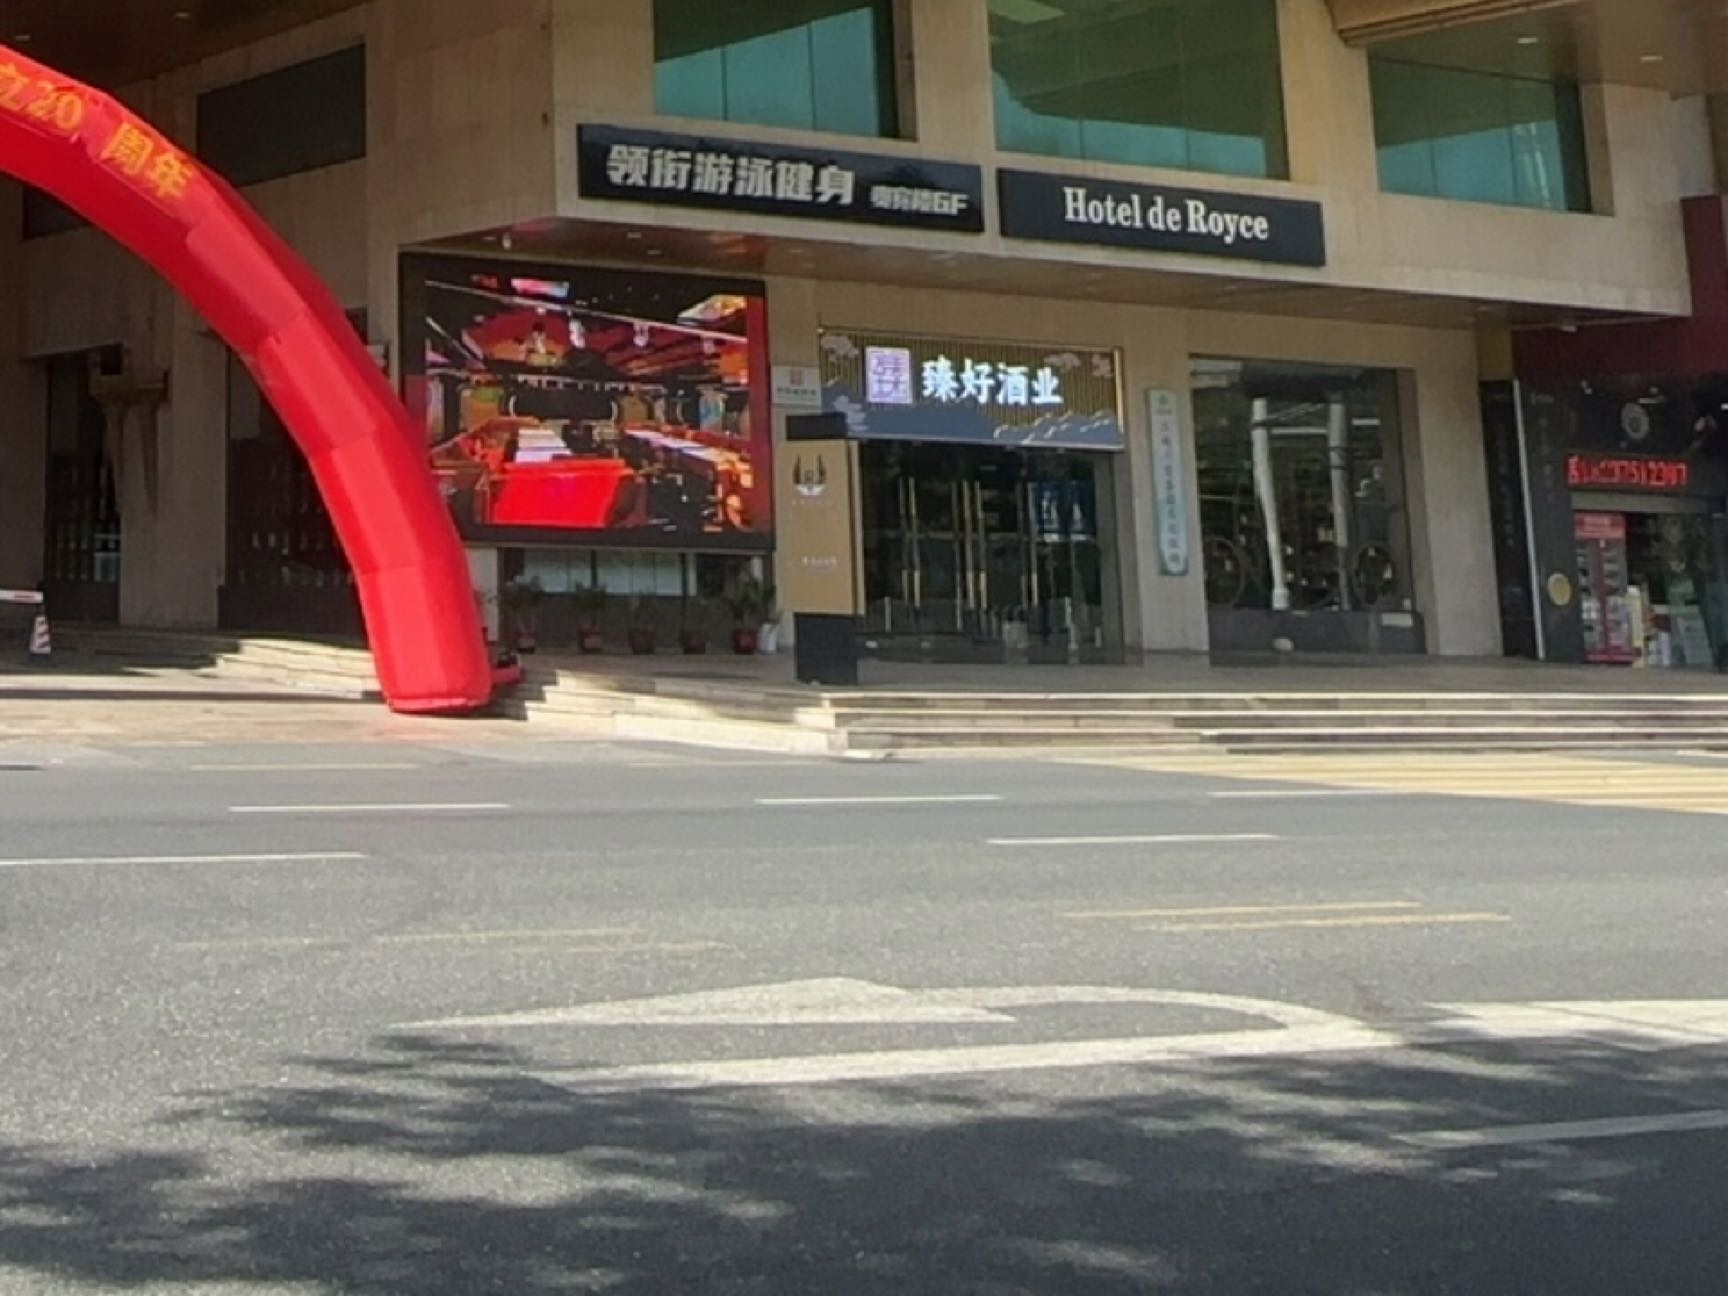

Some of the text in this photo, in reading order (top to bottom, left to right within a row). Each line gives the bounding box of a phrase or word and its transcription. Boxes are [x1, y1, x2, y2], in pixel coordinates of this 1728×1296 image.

[1063, 186, 1269, 245] Hotel de Royce
[922, 354, 1065, 406] 臻好酒业
